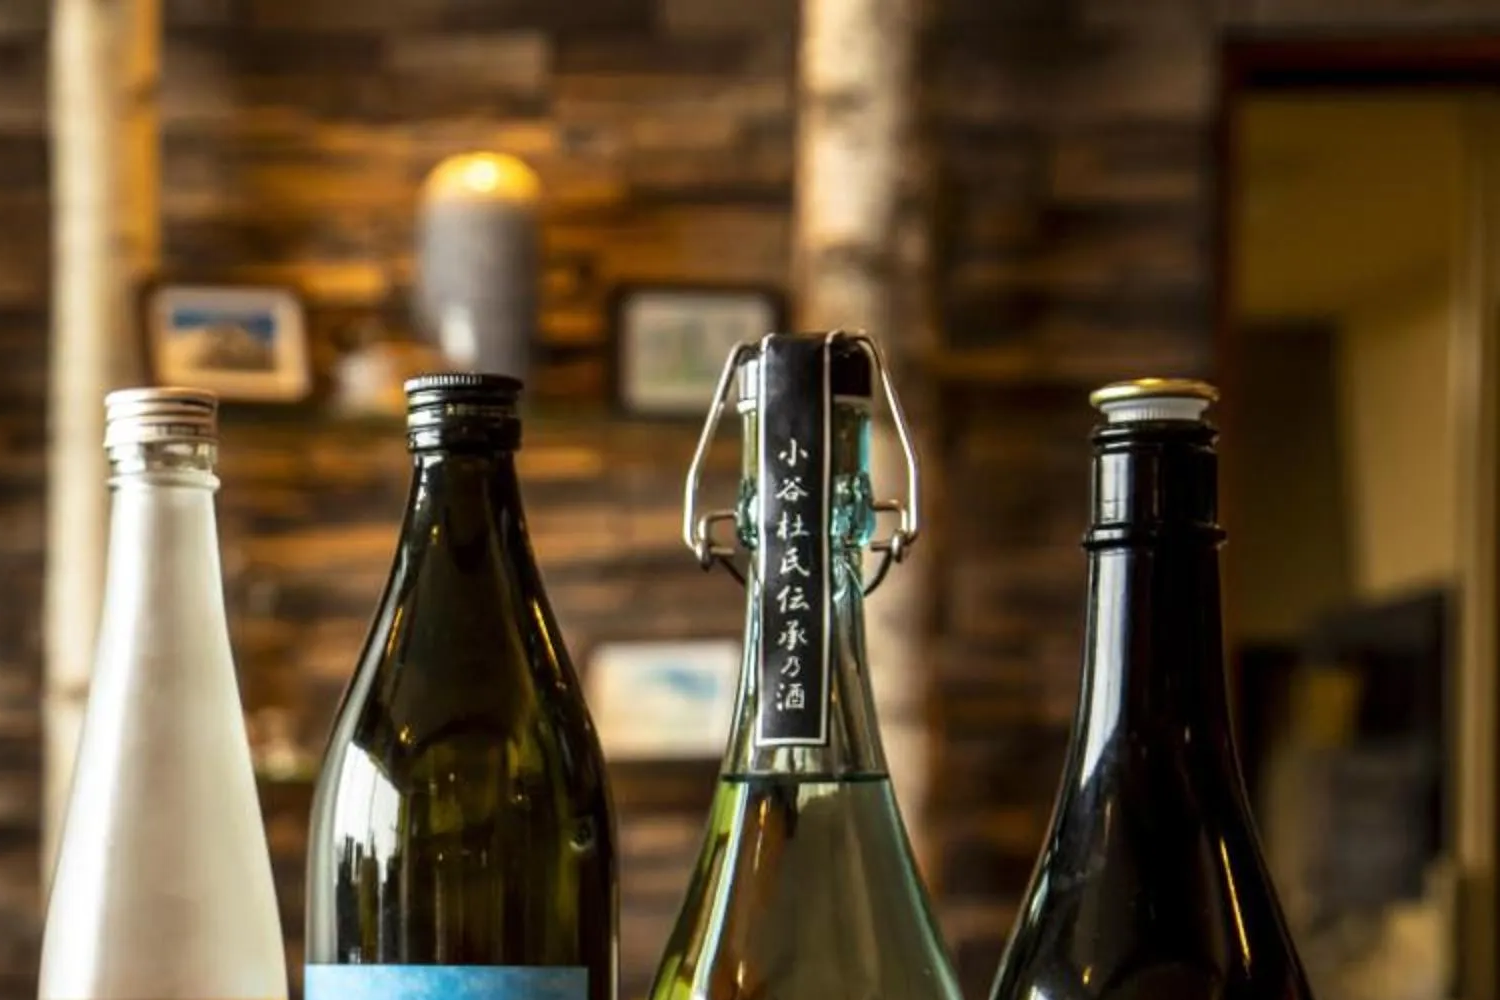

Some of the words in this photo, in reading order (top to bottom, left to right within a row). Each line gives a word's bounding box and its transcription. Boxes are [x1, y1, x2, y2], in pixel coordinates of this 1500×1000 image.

[776, 438, 810, 711] 小谷杜氏伝承乃酒
